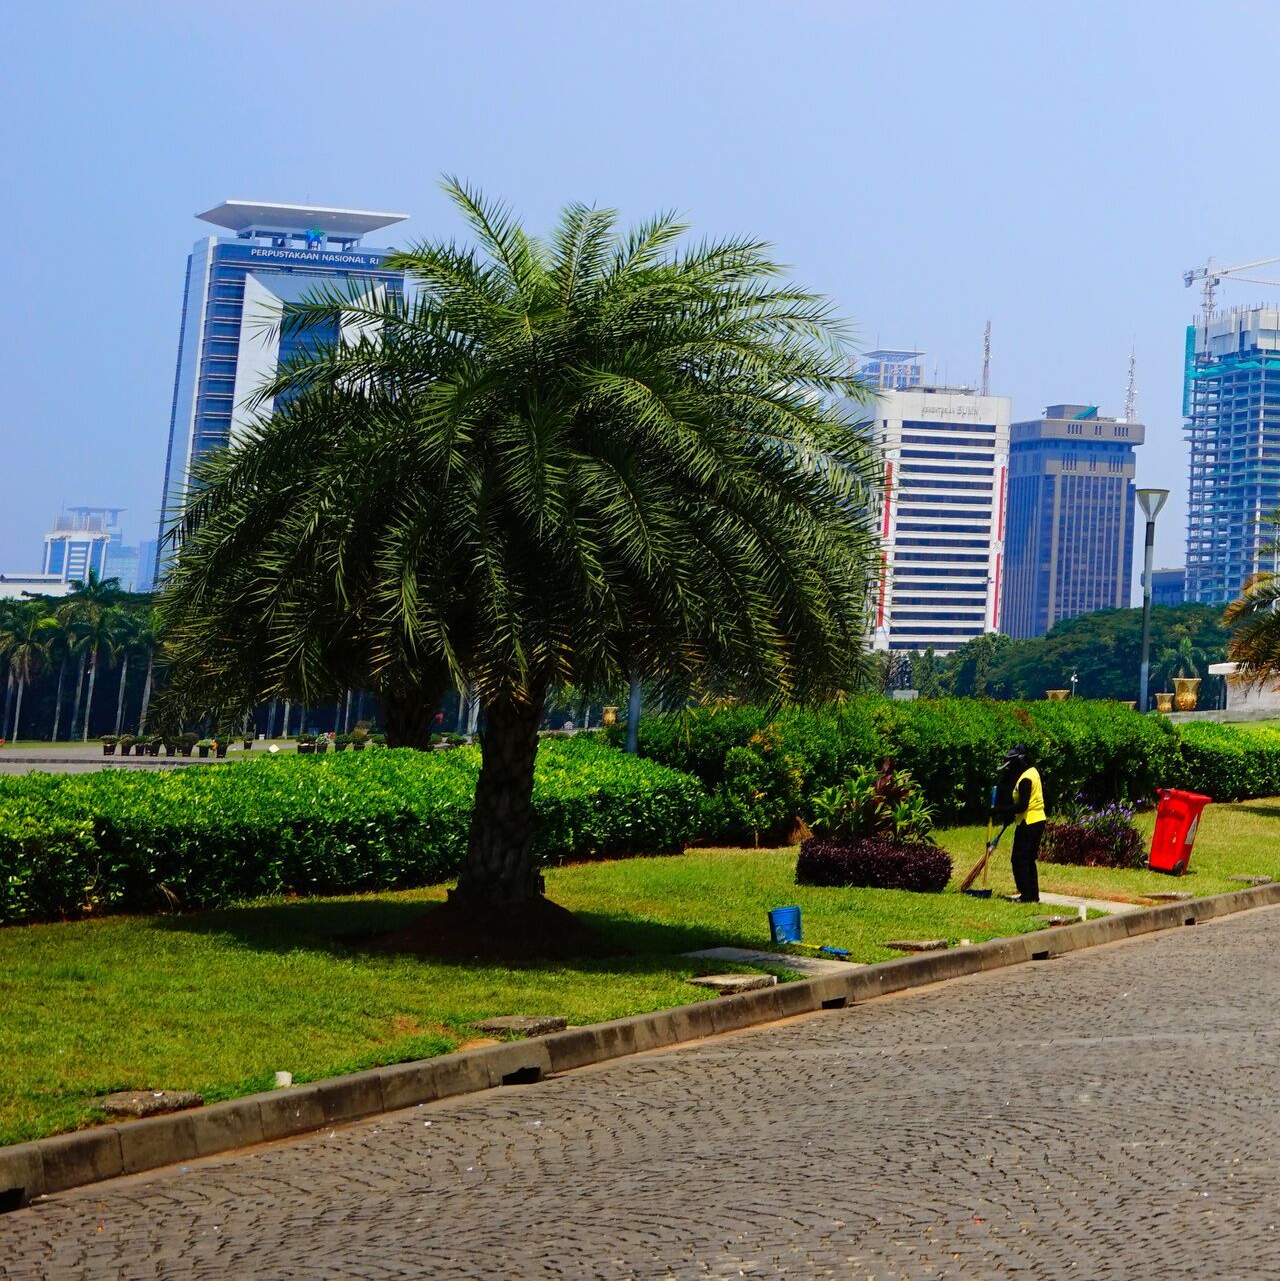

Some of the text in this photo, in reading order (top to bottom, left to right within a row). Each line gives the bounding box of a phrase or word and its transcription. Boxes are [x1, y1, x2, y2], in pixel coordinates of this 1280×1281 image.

[251, 248, 379, 265] PERPUSTAKAAN NASIONAL RI
